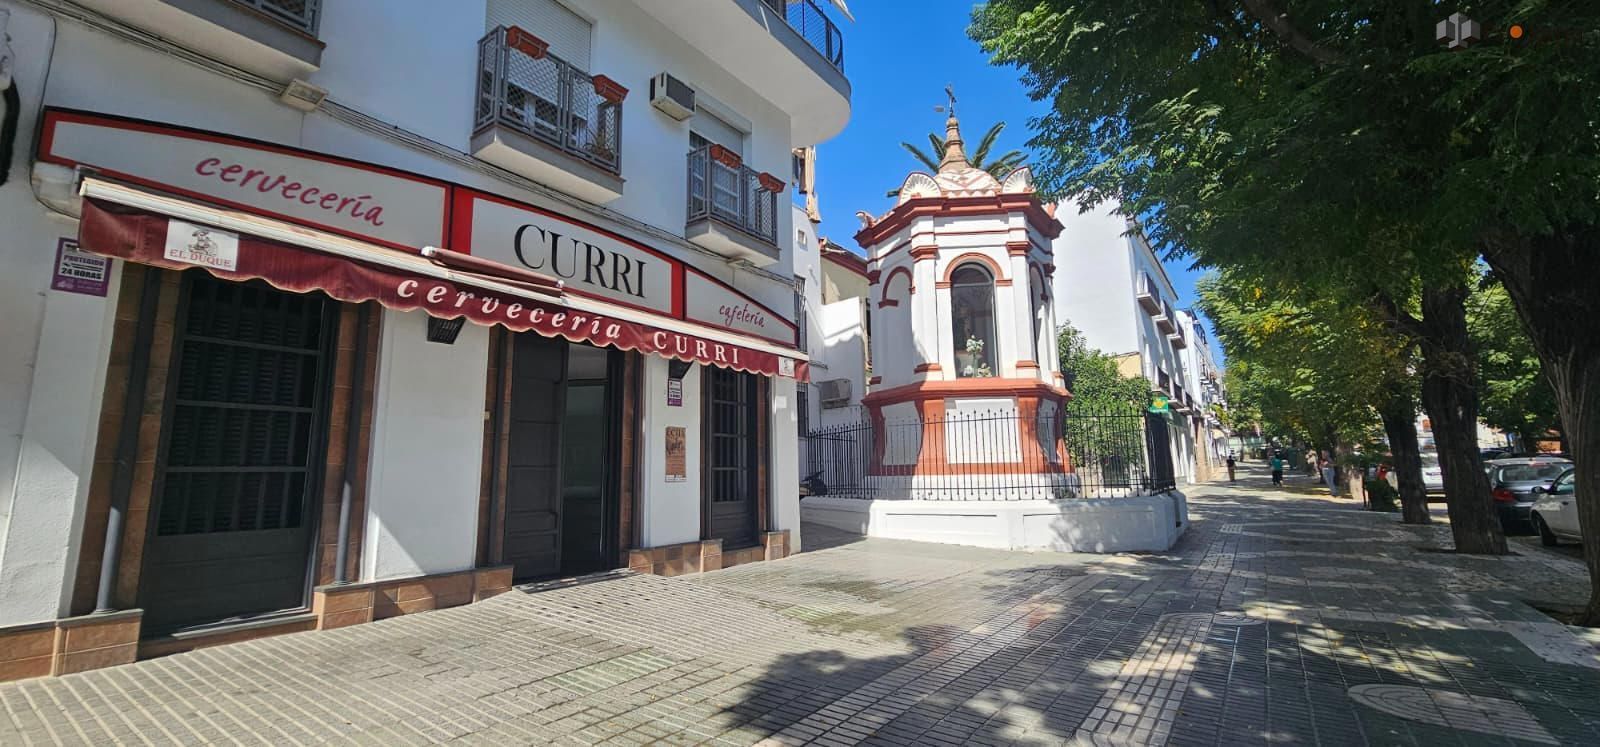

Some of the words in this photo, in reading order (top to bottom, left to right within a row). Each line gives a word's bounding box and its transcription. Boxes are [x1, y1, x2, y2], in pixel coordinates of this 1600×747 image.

[195, 157, 385, 226] cervecería
[61, 267, 73, 275] 24
[73, 269, 102, 280] HORAS
[169, 248, 187, 259] EL
[190, 252, 232, 267] DUQUE
[514, 224, 647, 298] CURRI
[397, 278, 621, 339] cervecería
[653, 331, 738, 364] CURRI
[719, 303, 765, 327] cafetería
